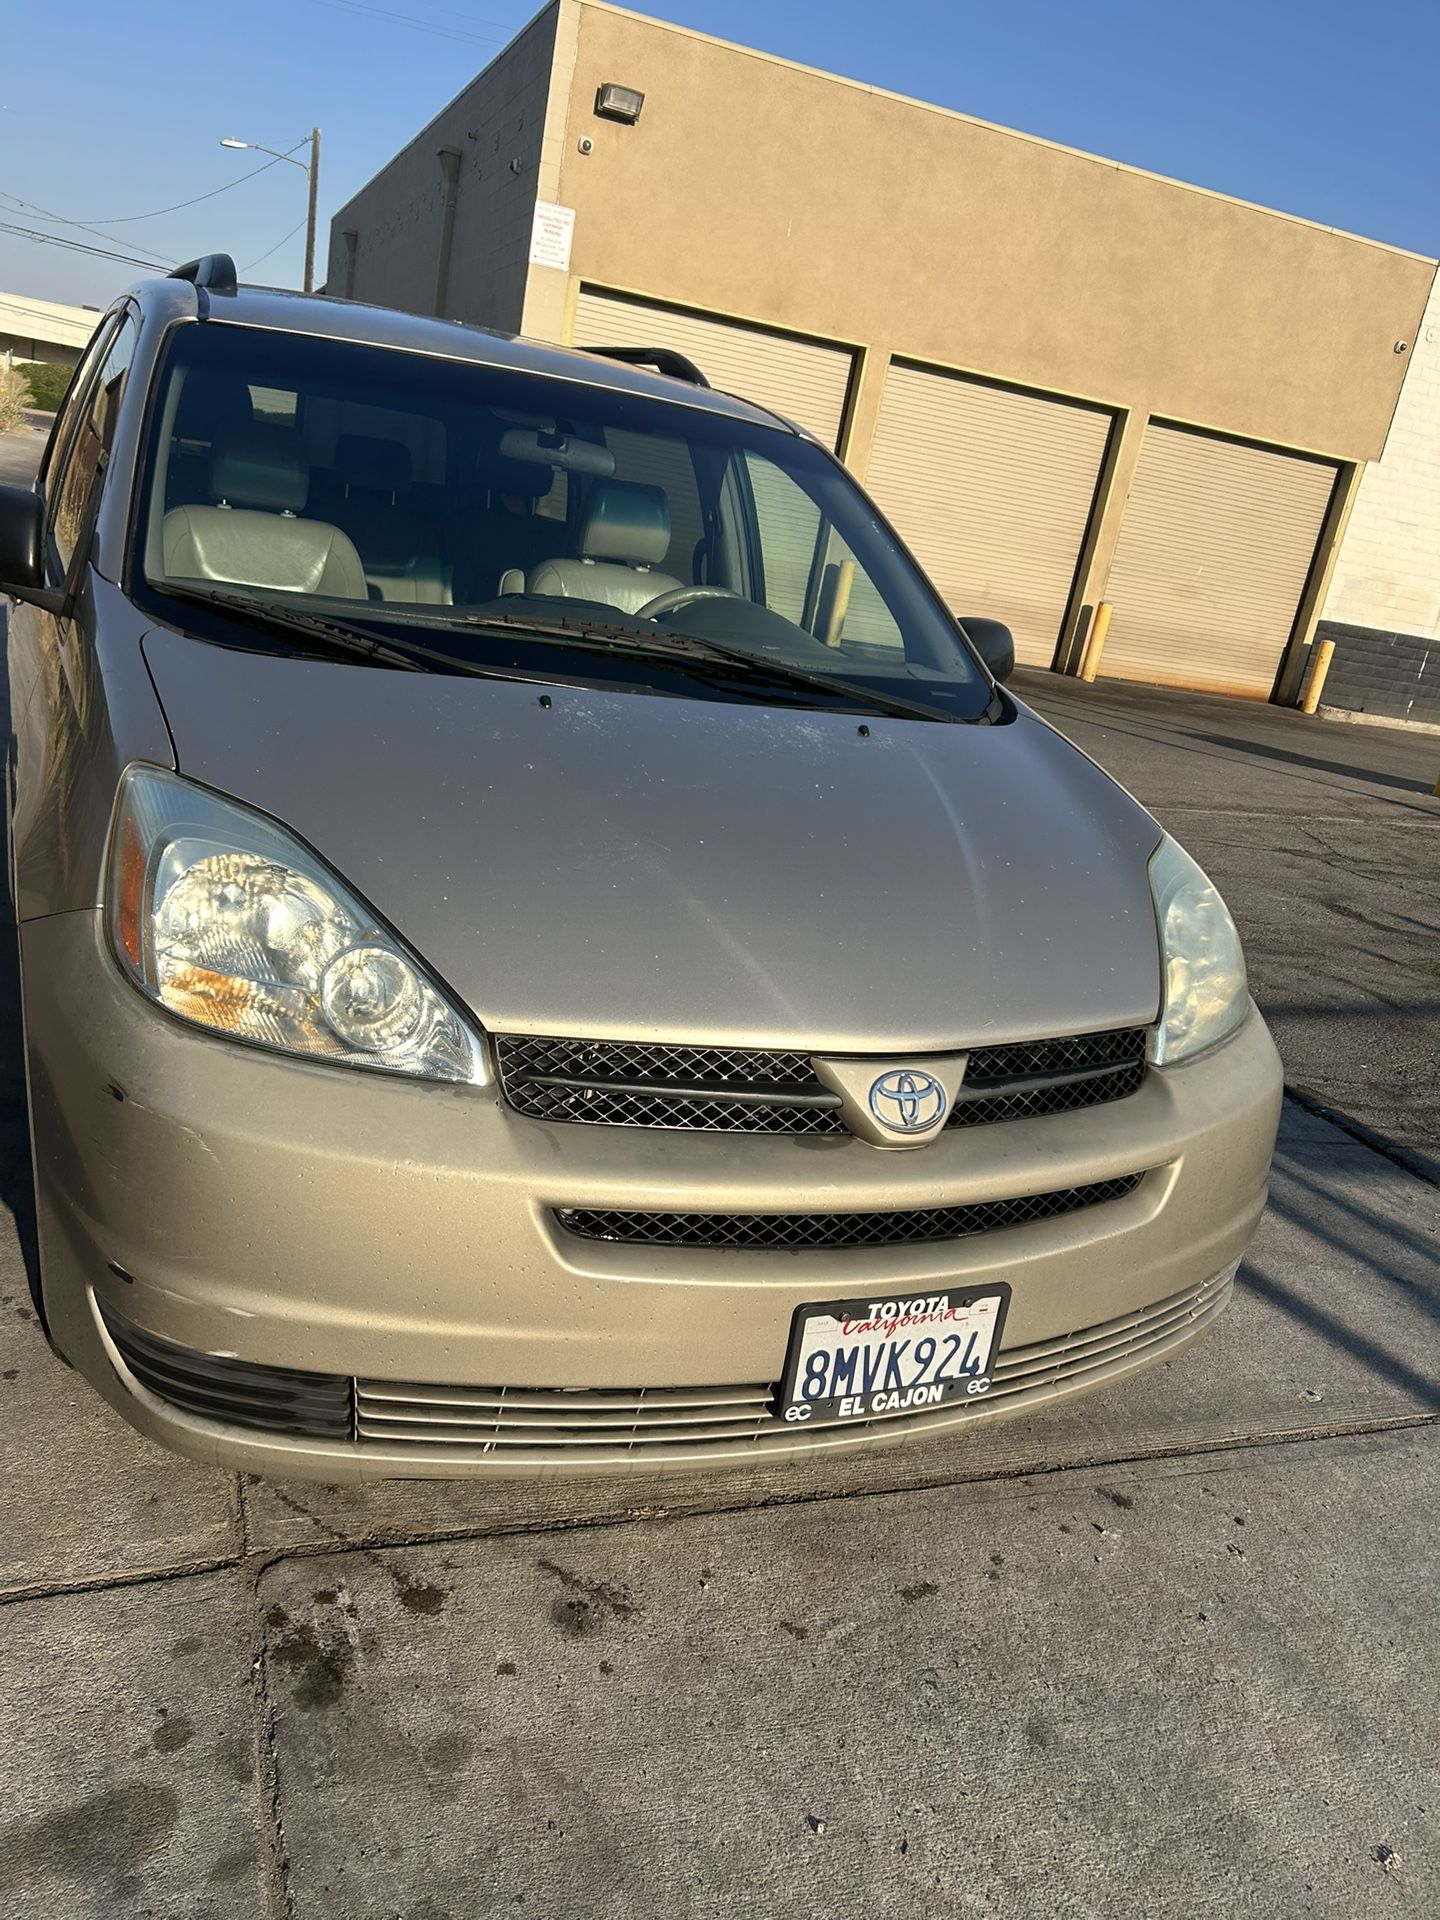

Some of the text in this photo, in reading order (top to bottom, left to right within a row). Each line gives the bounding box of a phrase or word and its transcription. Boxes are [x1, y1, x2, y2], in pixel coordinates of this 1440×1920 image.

[843, 1308, 968, 1338] California
[868, 1296, 949, 1320] TOYOTA
[802, 1331, 980, 1400] 8MVK924
[838, 1384, 944, 1417] EL CAJON
